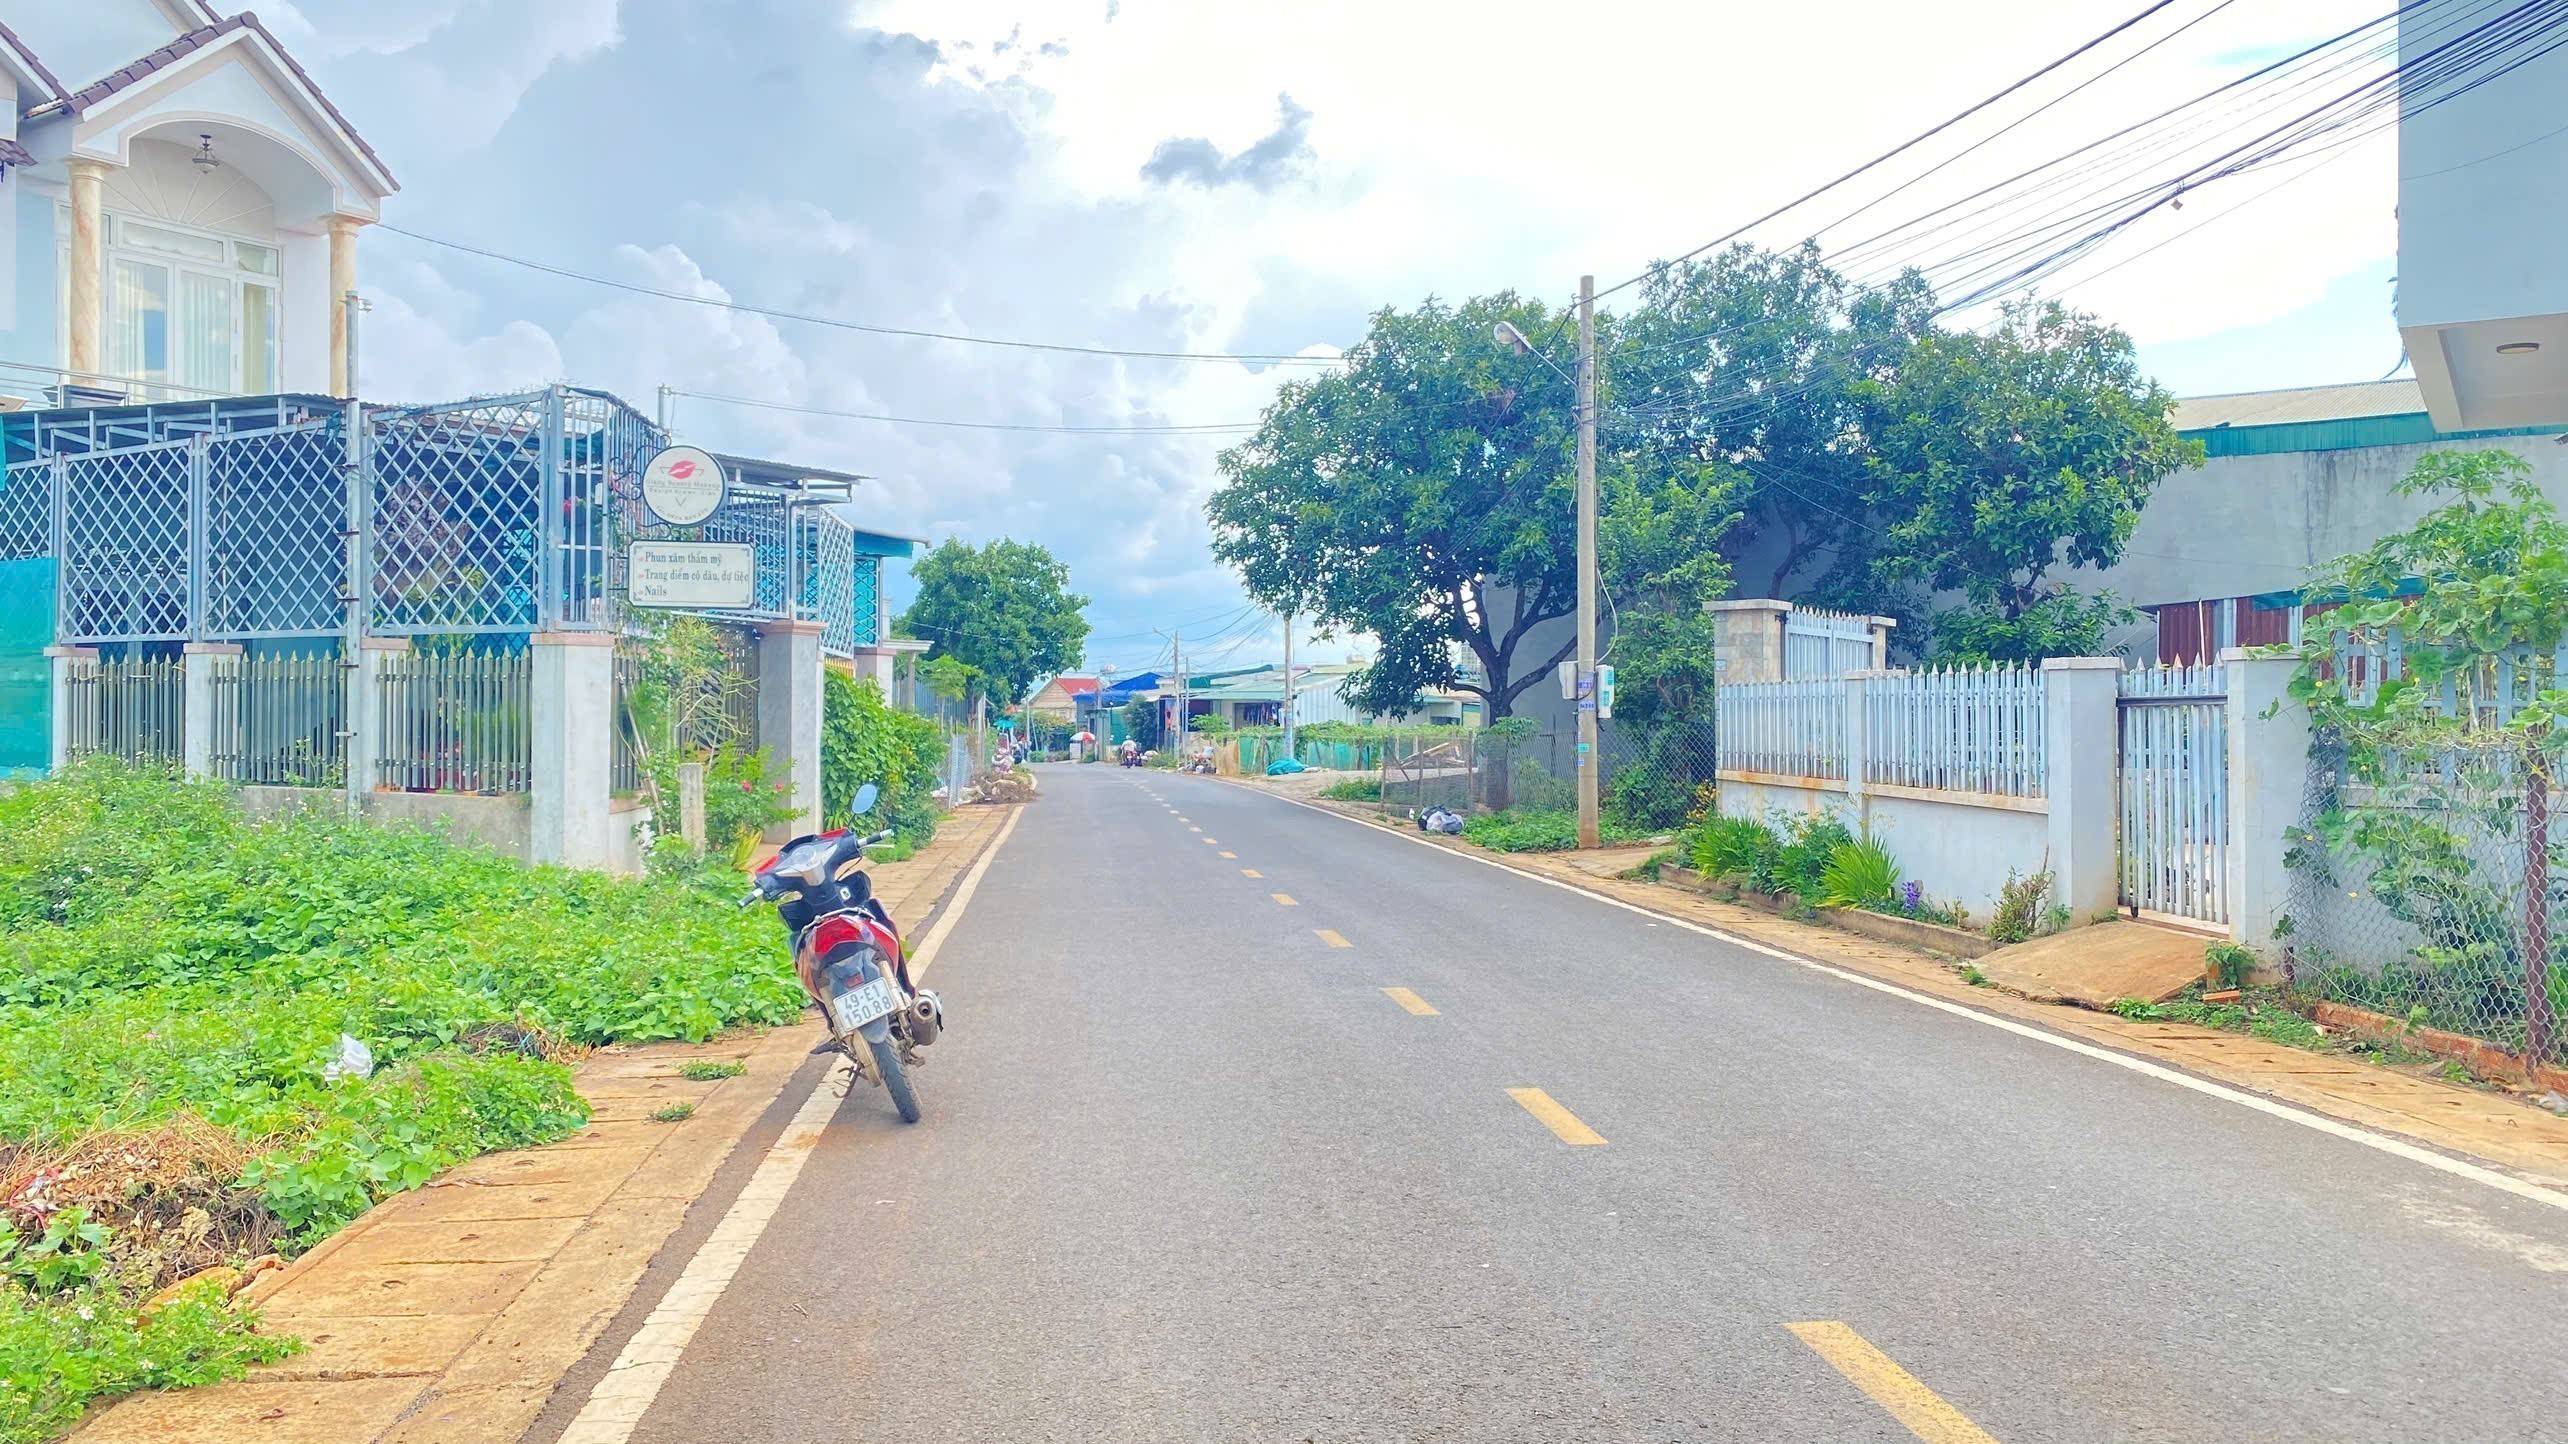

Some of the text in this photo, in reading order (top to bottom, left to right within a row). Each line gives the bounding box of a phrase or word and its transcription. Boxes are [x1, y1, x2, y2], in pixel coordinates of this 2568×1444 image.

[645, 551, 666, 563] Phun
[644, 568, 668, 582] Trang
[644, 585, 667, 596] Nails
[845, 984, 880, 1010] 49-E1
